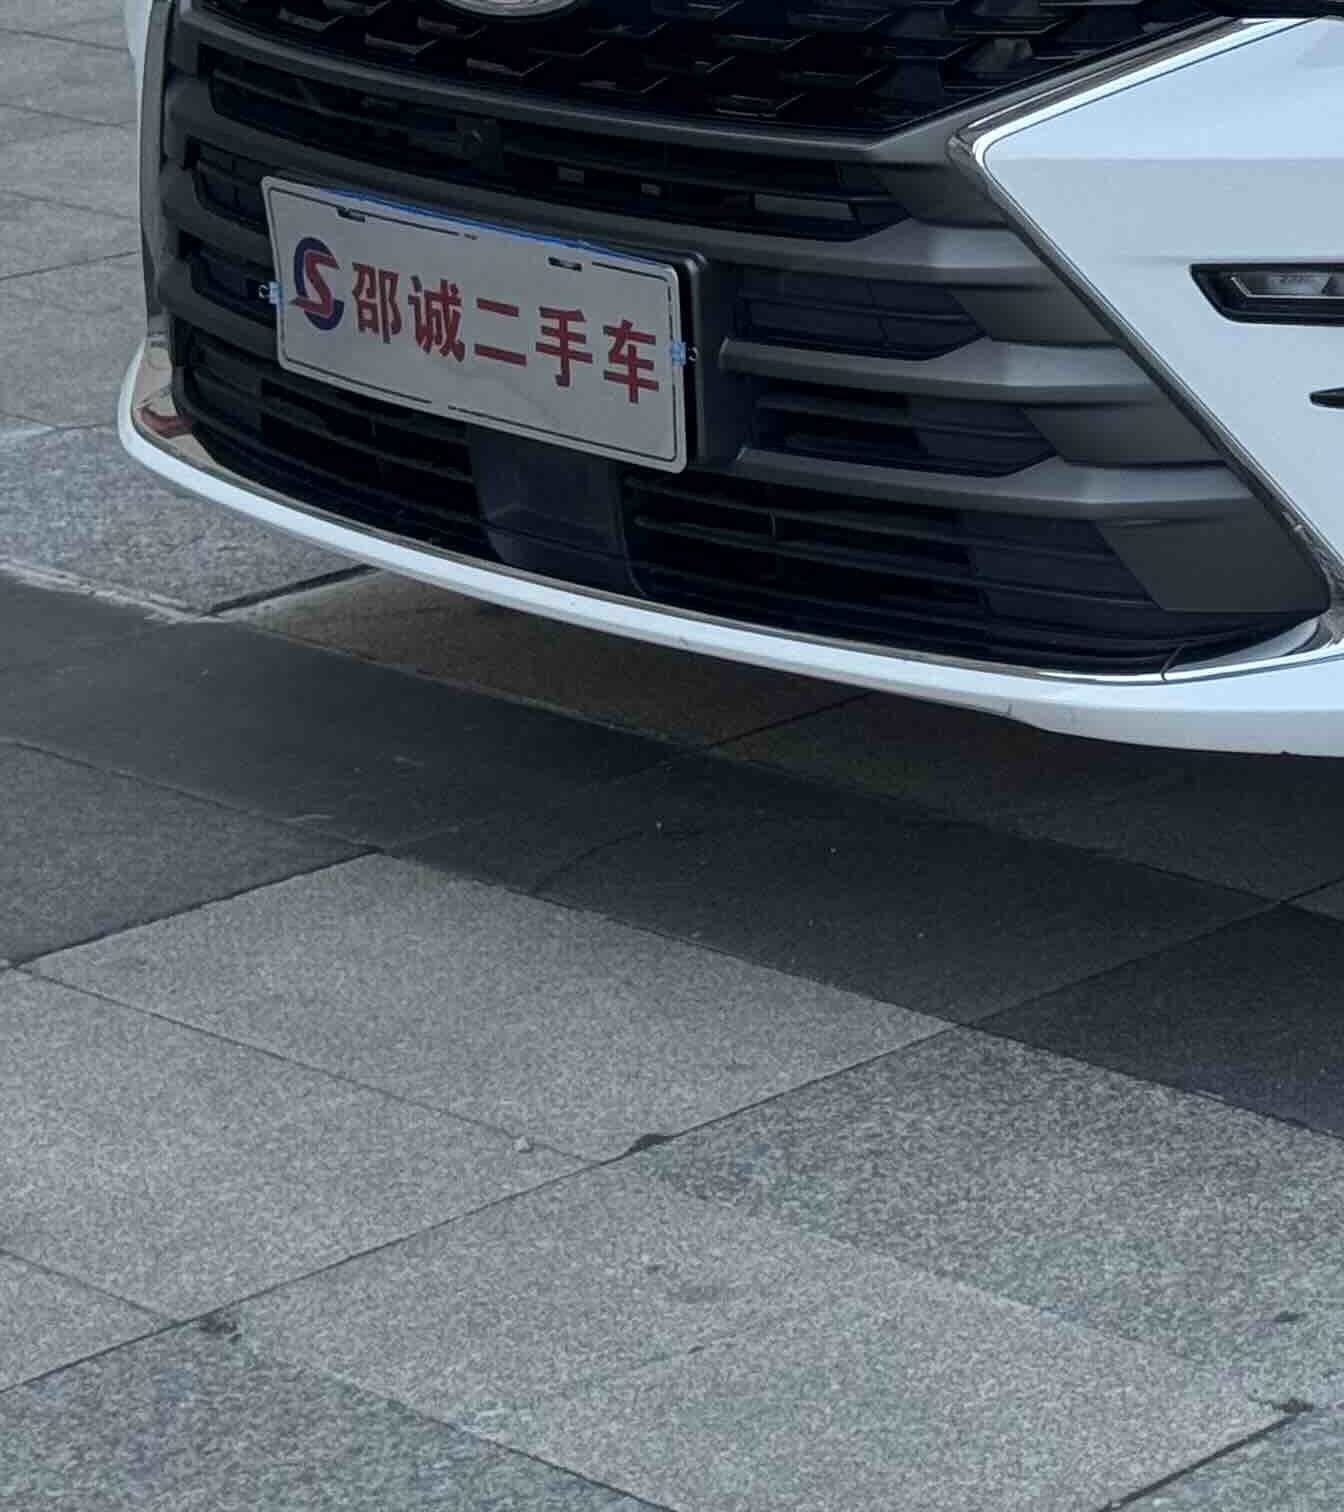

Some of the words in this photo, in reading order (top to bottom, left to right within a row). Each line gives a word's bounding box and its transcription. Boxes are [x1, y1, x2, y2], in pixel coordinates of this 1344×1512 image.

[350, 261, 660, 405] 邵诚二手车
